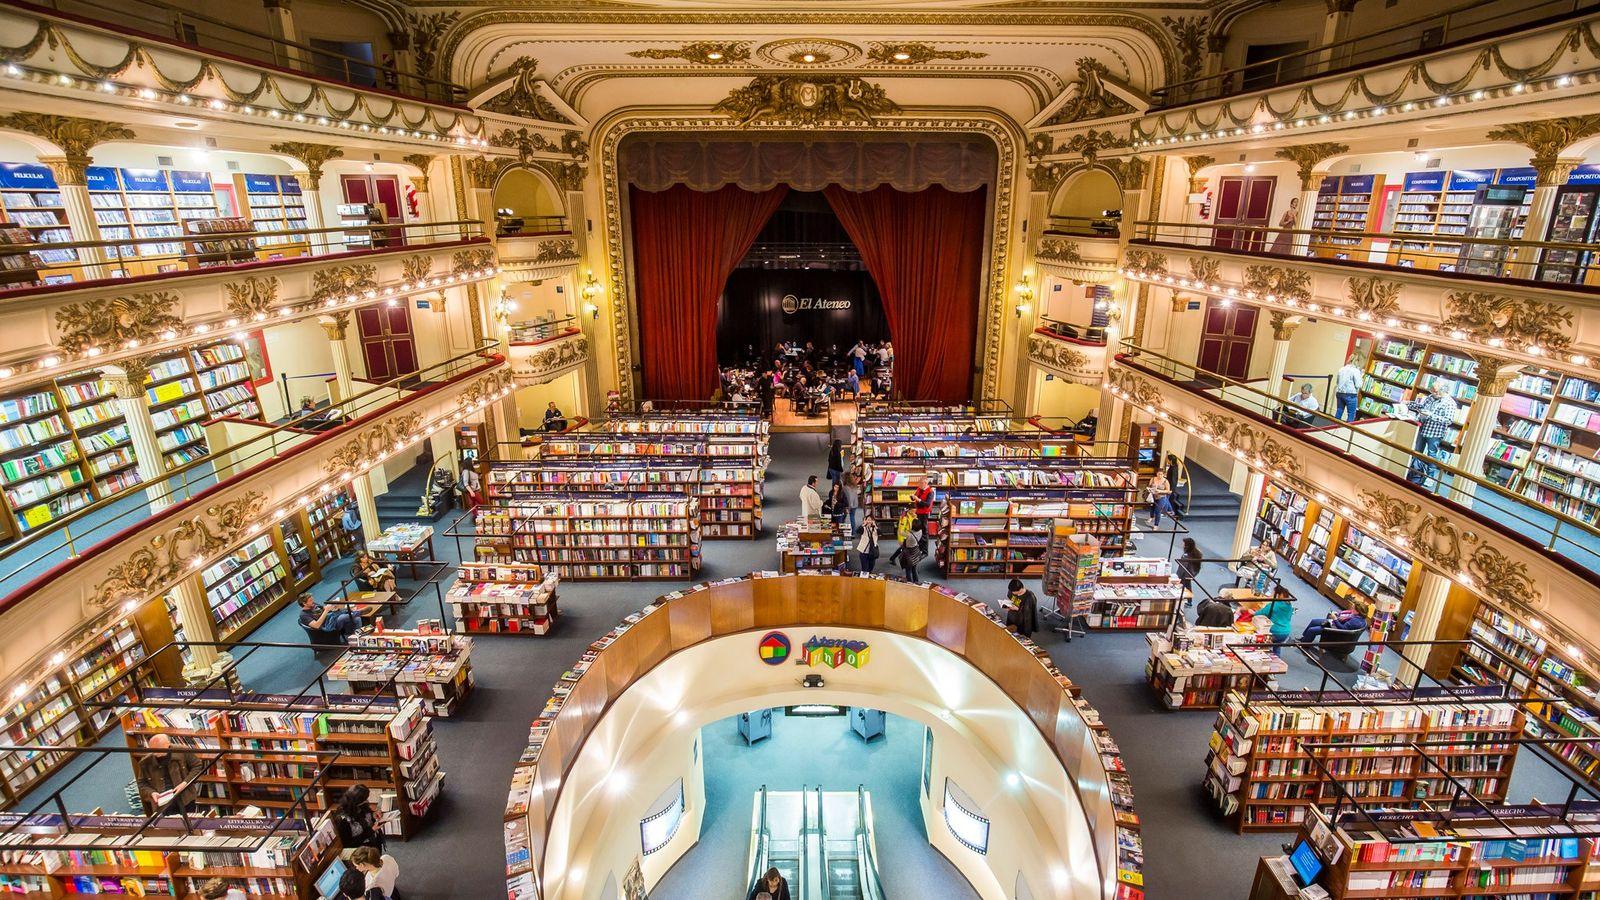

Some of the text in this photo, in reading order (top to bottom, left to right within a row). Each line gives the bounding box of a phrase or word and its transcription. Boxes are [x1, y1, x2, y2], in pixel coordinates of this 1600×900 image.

[799, 298, 851, 309] El Ateneo
[808, 634, 868, 648] Ateneo
[803, 650, 869, 666] Junior
